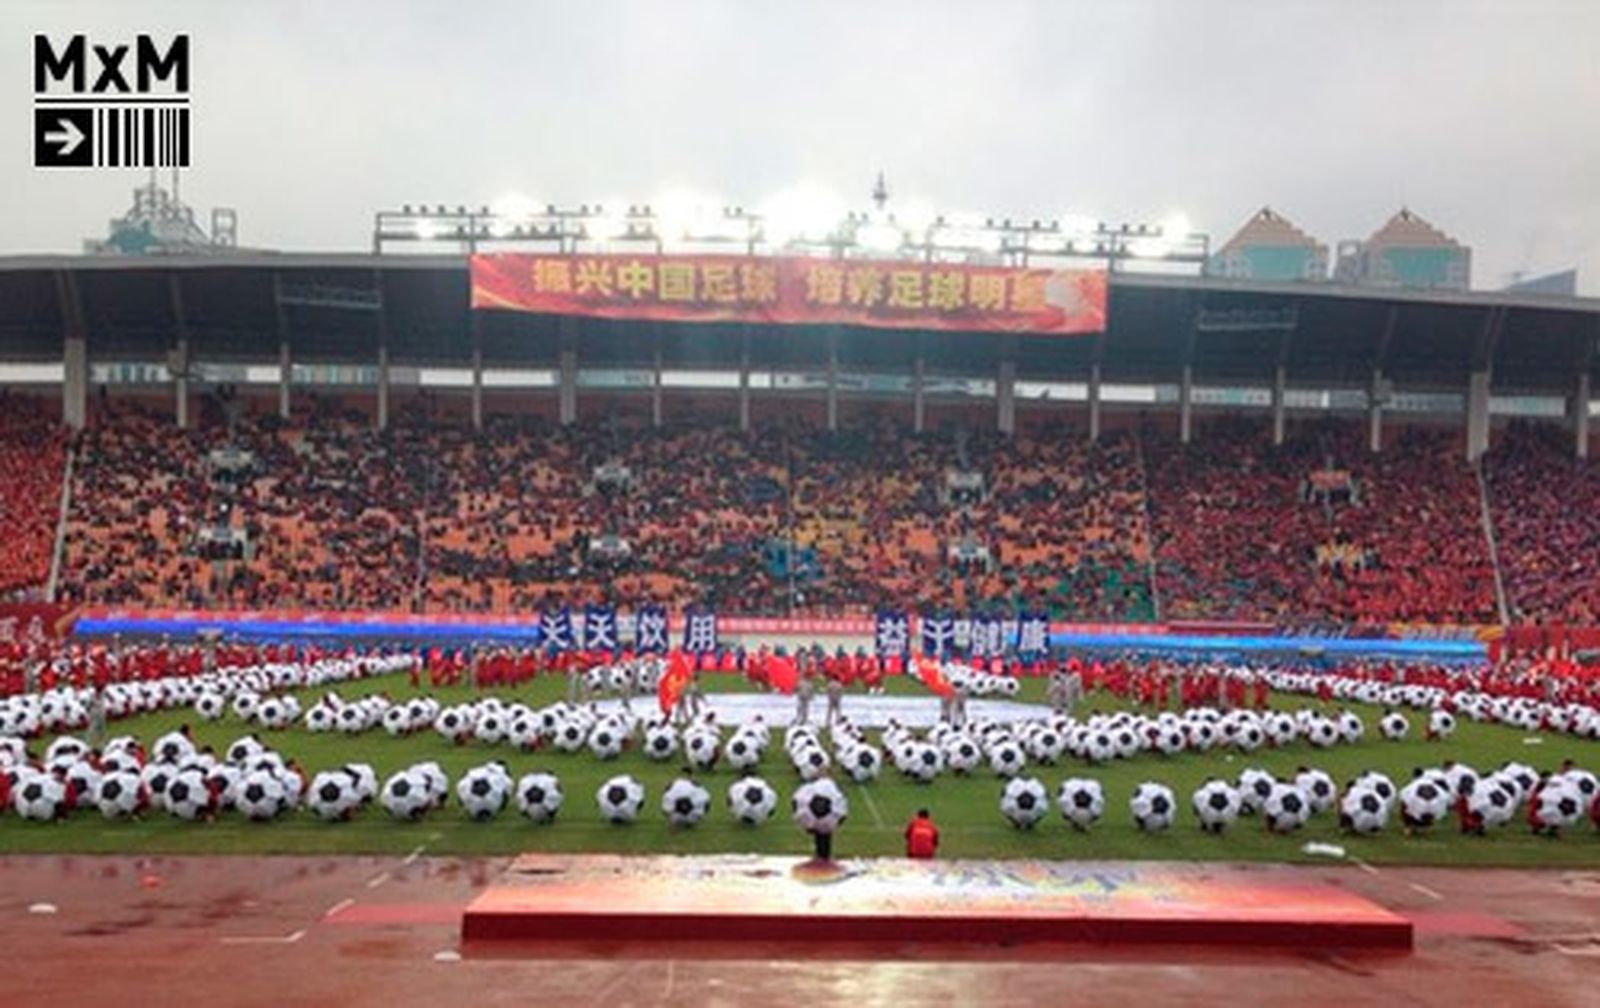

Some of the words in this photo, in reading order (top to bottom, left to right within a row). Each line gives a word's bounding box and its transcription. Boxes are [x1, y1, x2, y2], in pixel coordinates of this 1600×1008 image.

[532, 257, 777, 302] 振兴中国足球
